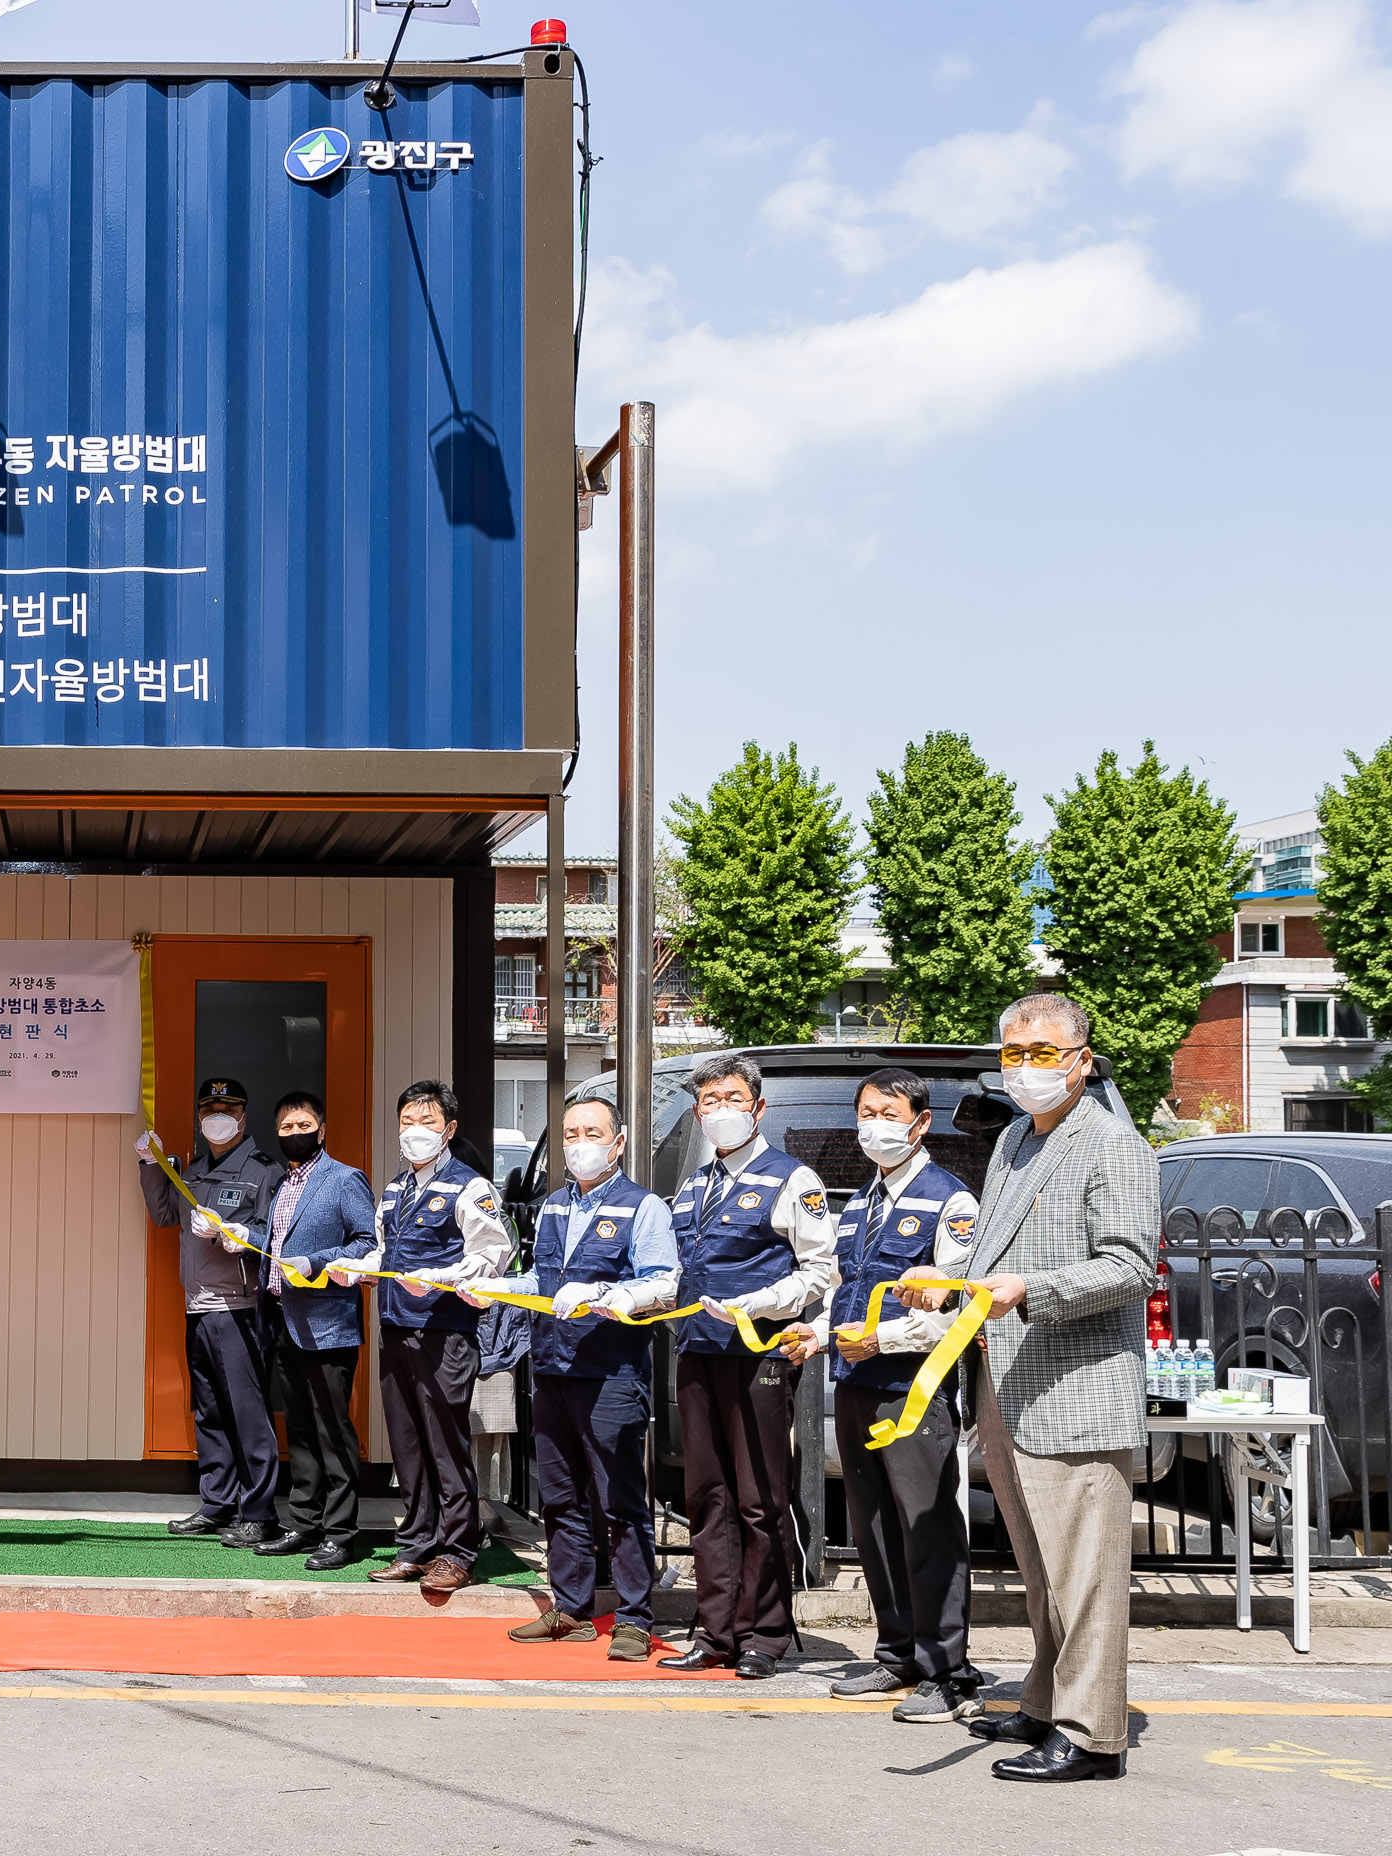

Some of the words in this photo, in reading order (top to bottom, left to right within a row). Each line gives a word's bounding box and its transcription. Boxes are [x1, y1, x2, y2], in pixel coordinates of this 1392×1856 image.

[358, 140, 474, 170] 광진구
[45, 434, 206, 474] 자율방범대
[75, 485, 206, 505] PATROL
[8, 976, 58, 991] 자양4동
[42, 997, 106, 1015] 통합초소
